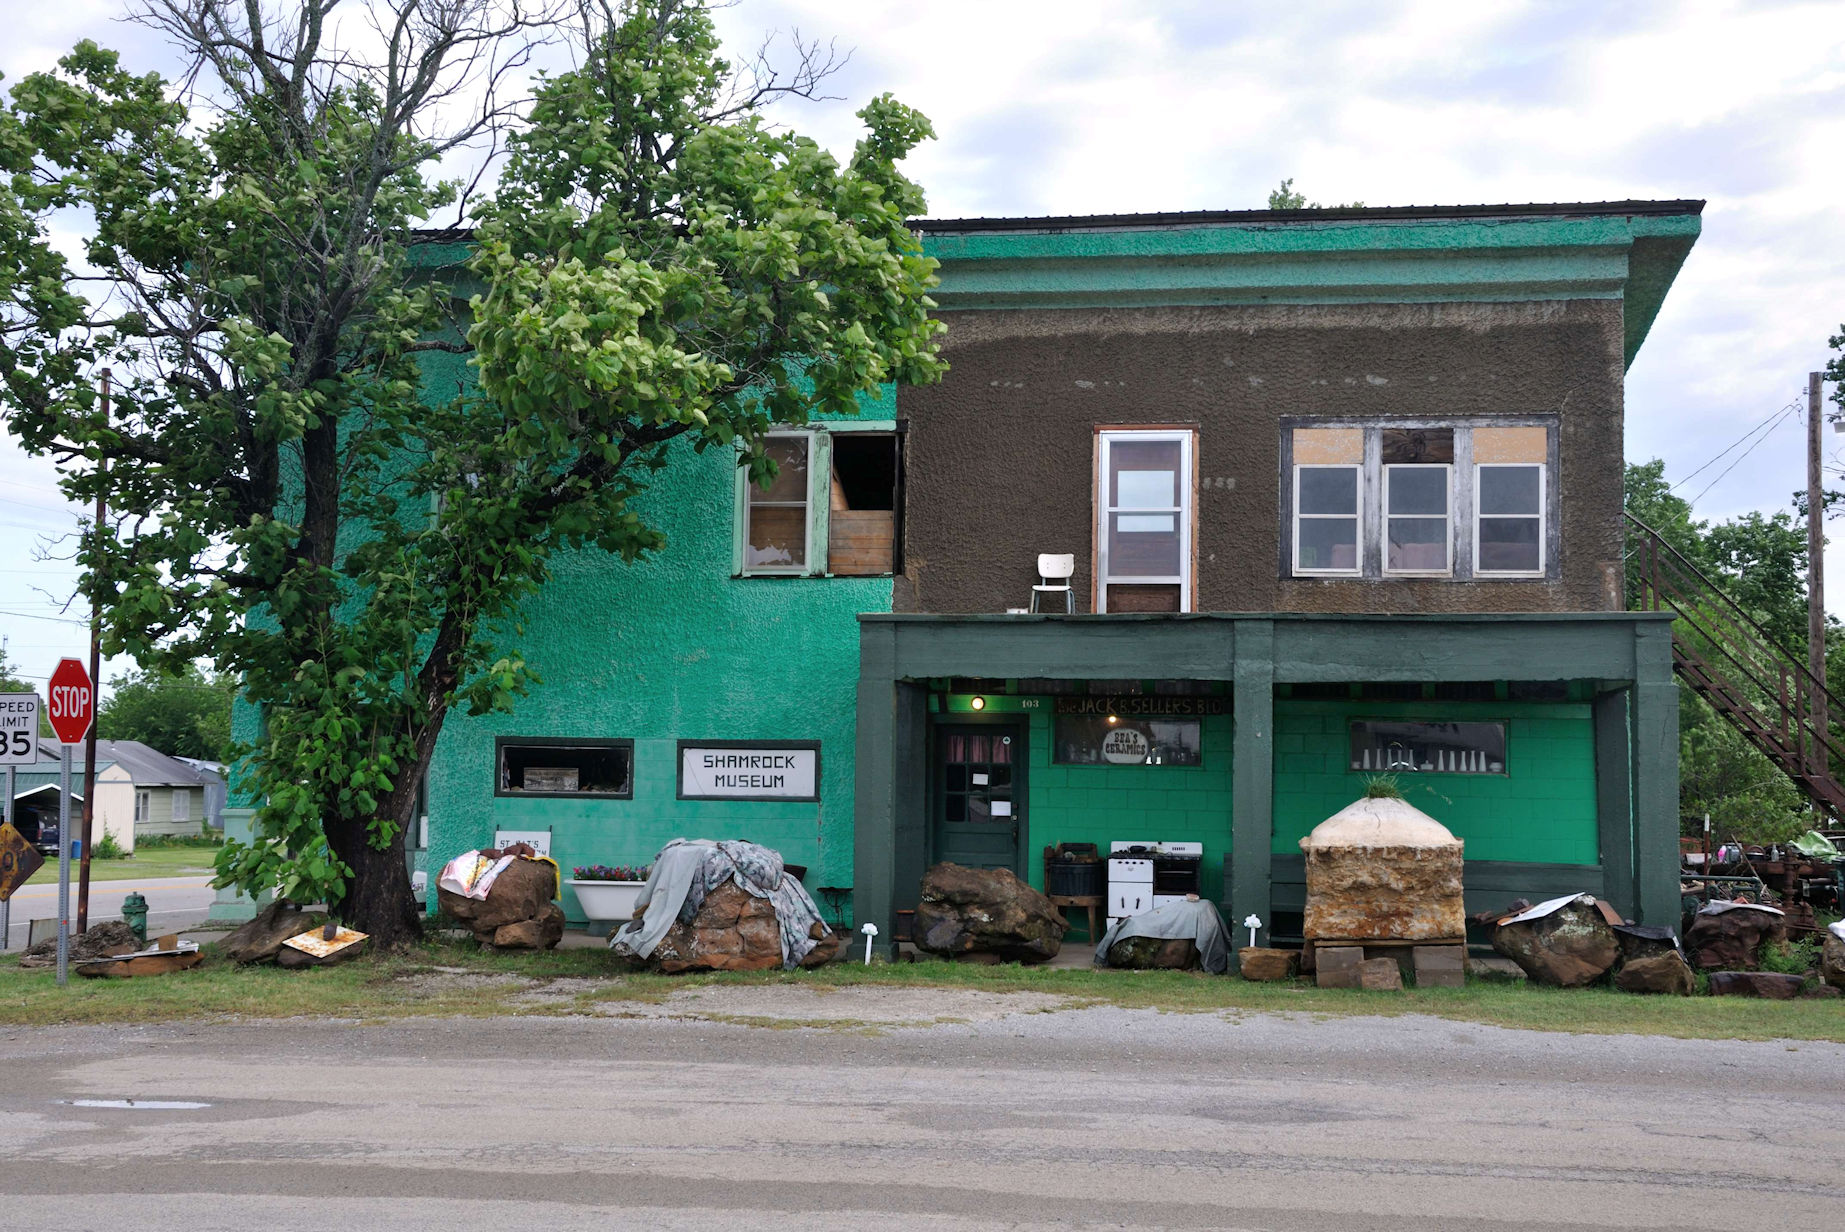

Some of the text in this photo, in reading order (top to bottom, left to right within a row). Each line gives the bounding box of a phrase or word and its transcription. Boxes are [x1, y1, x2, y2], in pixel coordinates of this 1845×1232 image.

[52, 685, 90, 718] STOP
[1021, 699, 1040, 709] 103
[1078, 696, 1117, 714] JACK
[1131, 697, 1193, 714] SELLERS
[0, 716, 29, 727] IMIT
[1114, 731, 1138, 743] BEA'S
[1105, 742, 1146, 755] CERAMICS
[703, 755, 796, 769] SHAMROCK
[715, 774, 784, 788] MUSEUM
